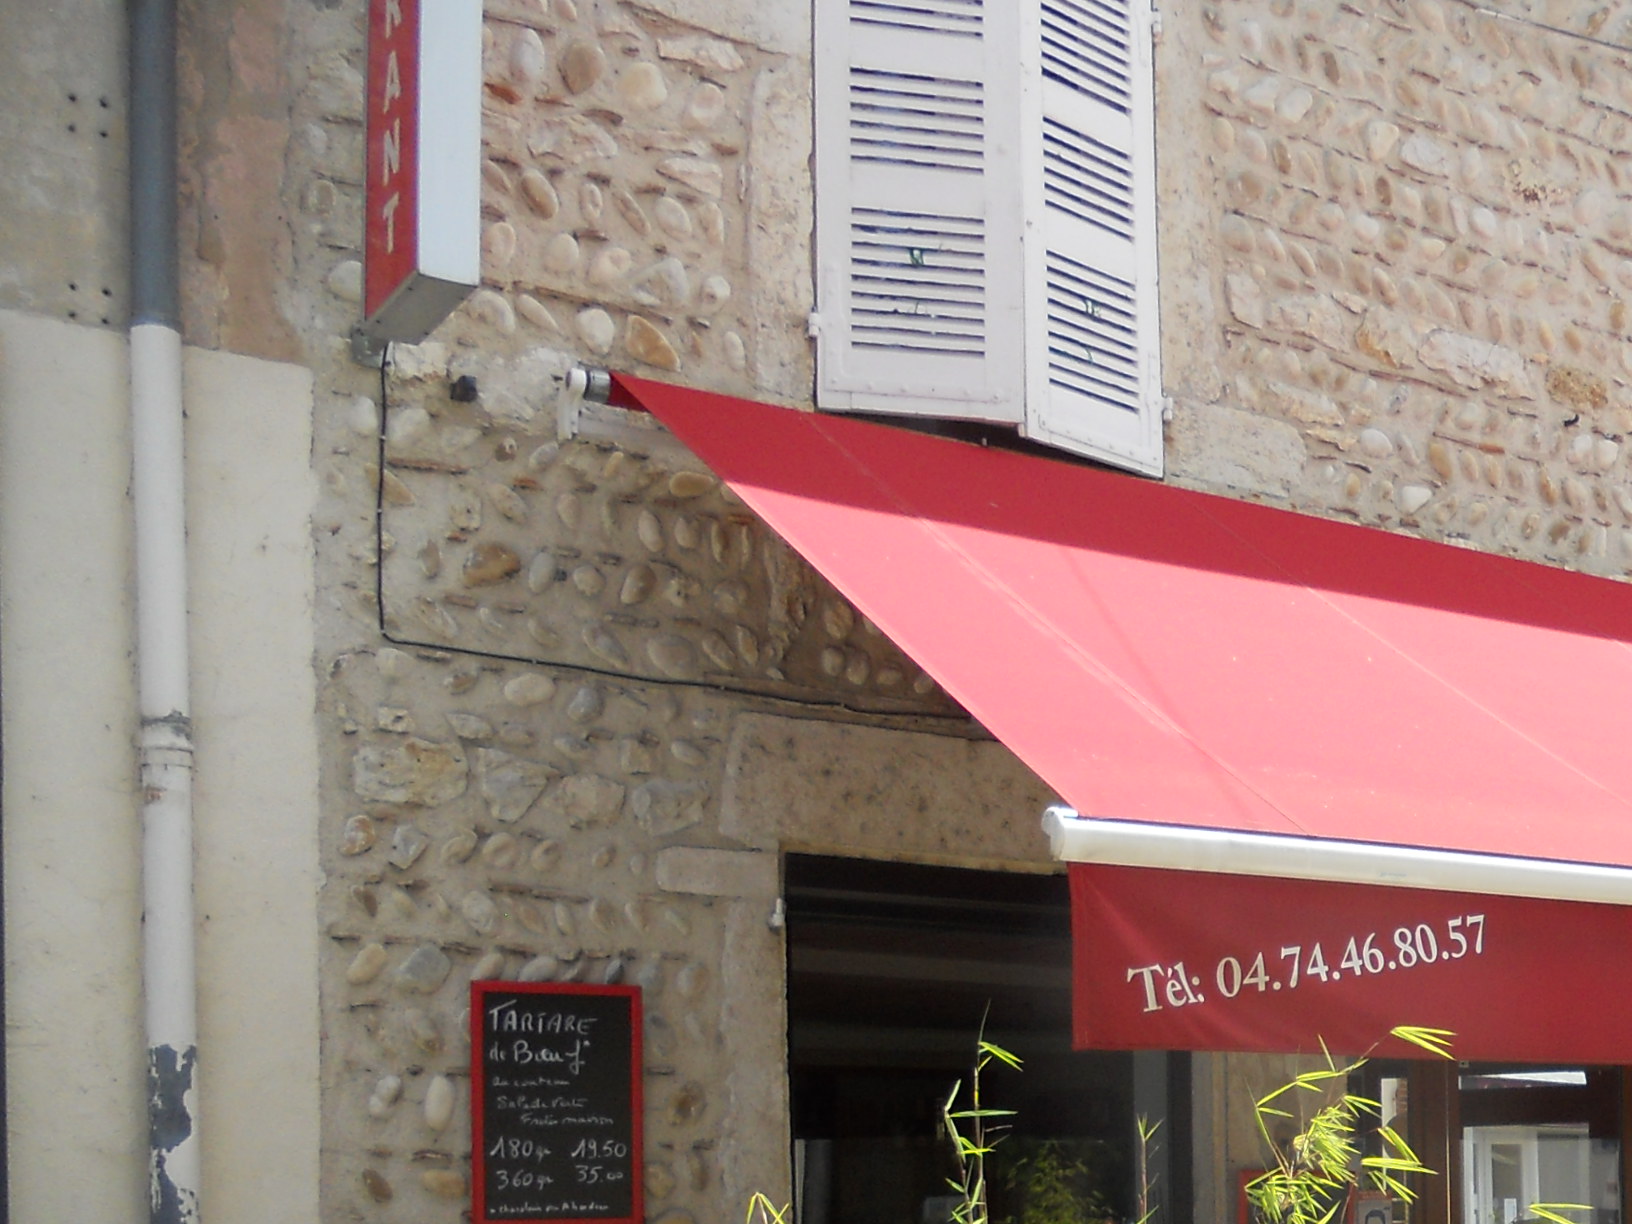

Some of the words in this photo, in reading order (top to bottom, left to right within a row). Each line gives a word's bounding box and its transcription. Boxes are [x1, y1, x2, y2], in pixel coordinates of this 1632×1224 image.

[1126, 961, 1205, 1013] Tél:
[1216, 914, 1487, 999] 04.74.46.80.57
[489, 999, 598, 1035] TARTARE
[571, 1138, 627, 1160] 19.50
